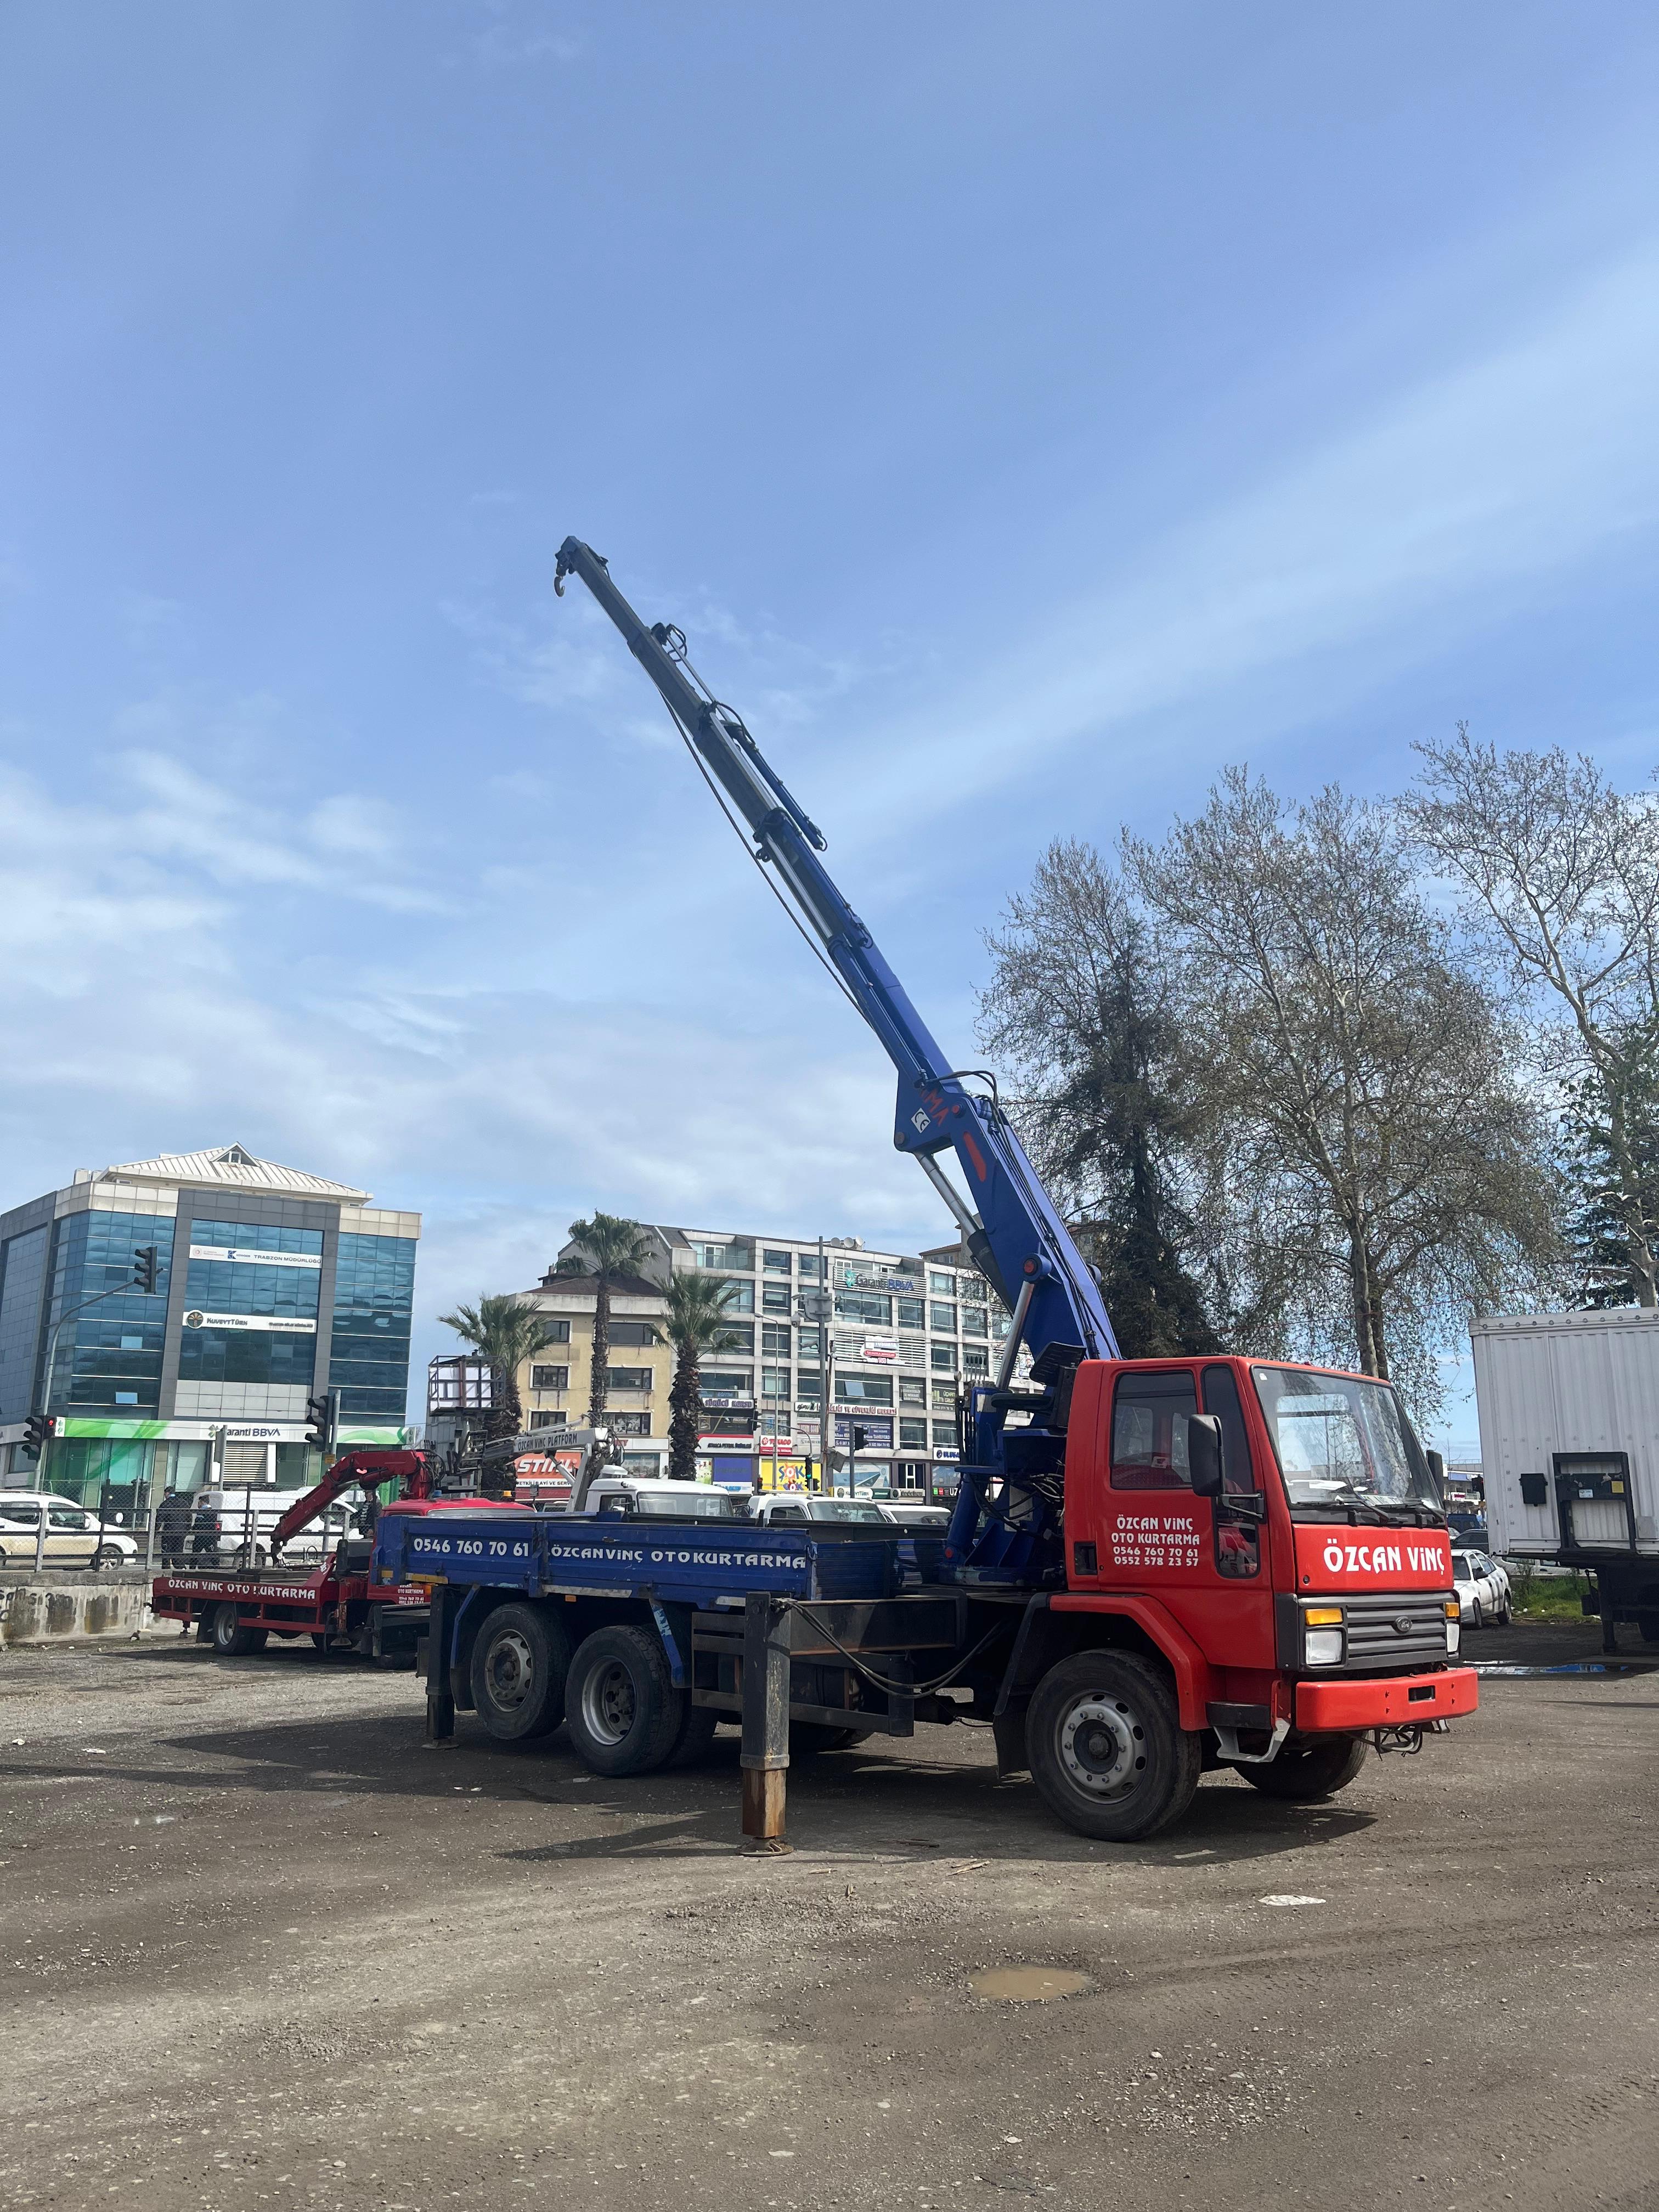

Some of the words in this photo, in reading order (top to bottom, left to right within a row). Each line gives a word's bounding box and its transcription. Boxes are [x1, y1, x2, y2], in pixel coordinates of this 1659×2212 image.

[227, 1427, 251, 1436] aranti
[252, 1428, 280, 1436] BBVA
[548, 1433, 578, 1447] PLATFORM
[778, 1464, 805, 1482] ŞOK
[1116, 1514, 1158, 1531] ÖZCAN
[1111, 1532, 1134, 1543] OTO
[1138, 1533, 1200, 1545] KURTARMA
[414, 1538, 451, 1553] 0546
[456, 1540, 483, 1555] 760
[489, 1541, 507, 1556] 70
[513, 1542, 529, 1556] 61
[1113, 1546, 1141, 1555] 0546
[1144, 1547, 1164, 1556] 760
[1169, 1548, 1182, 1556] 70
[1187, 1549, 1198, 1557] 61
[1114, 1556, 1140, 1565] 0552
[1144, 1557, 1164, 1565] 578
[1168, 1558, 1182, 1566] 23
[1186, 1558, 1199, 1566] 57
[1323, 1538, 1402, 1574] ÖZCAN
[227, 1584, 250, 1594] OTO
